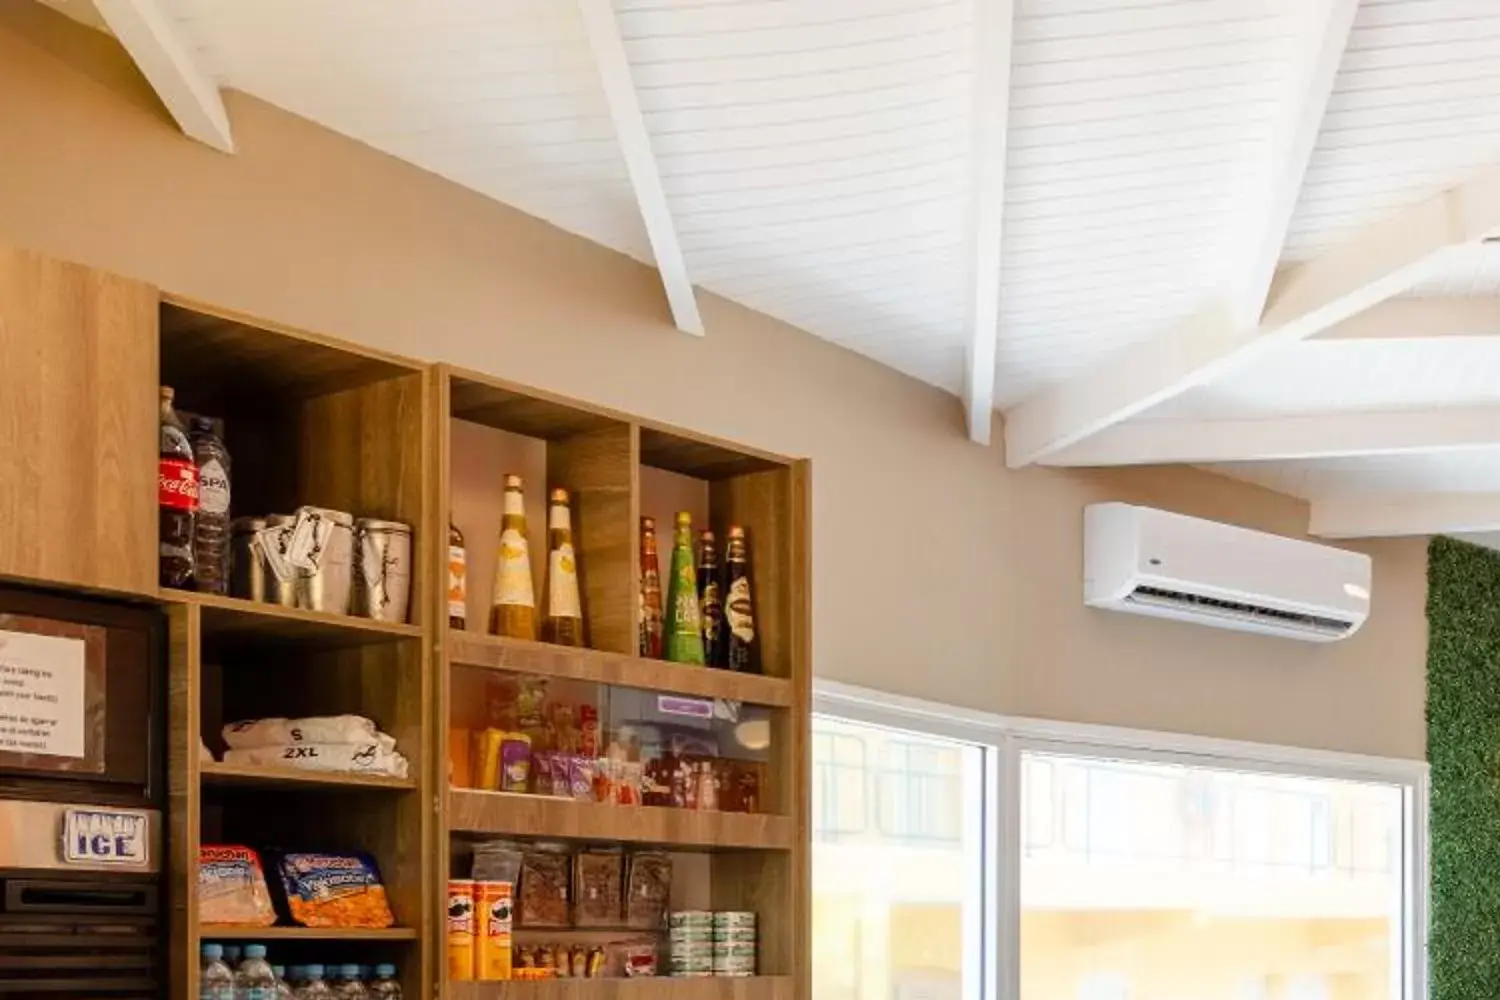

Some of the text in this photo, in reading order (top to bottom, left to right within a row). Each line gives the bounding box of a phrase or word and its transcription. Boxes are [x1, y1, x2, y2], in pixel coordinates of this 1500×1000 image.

[199, 475, 227, 489] SPA
[289, 728, 304, 741] S
[283, 747, 319, 760] 2XL
[77, 834, 136, 857] ICE
